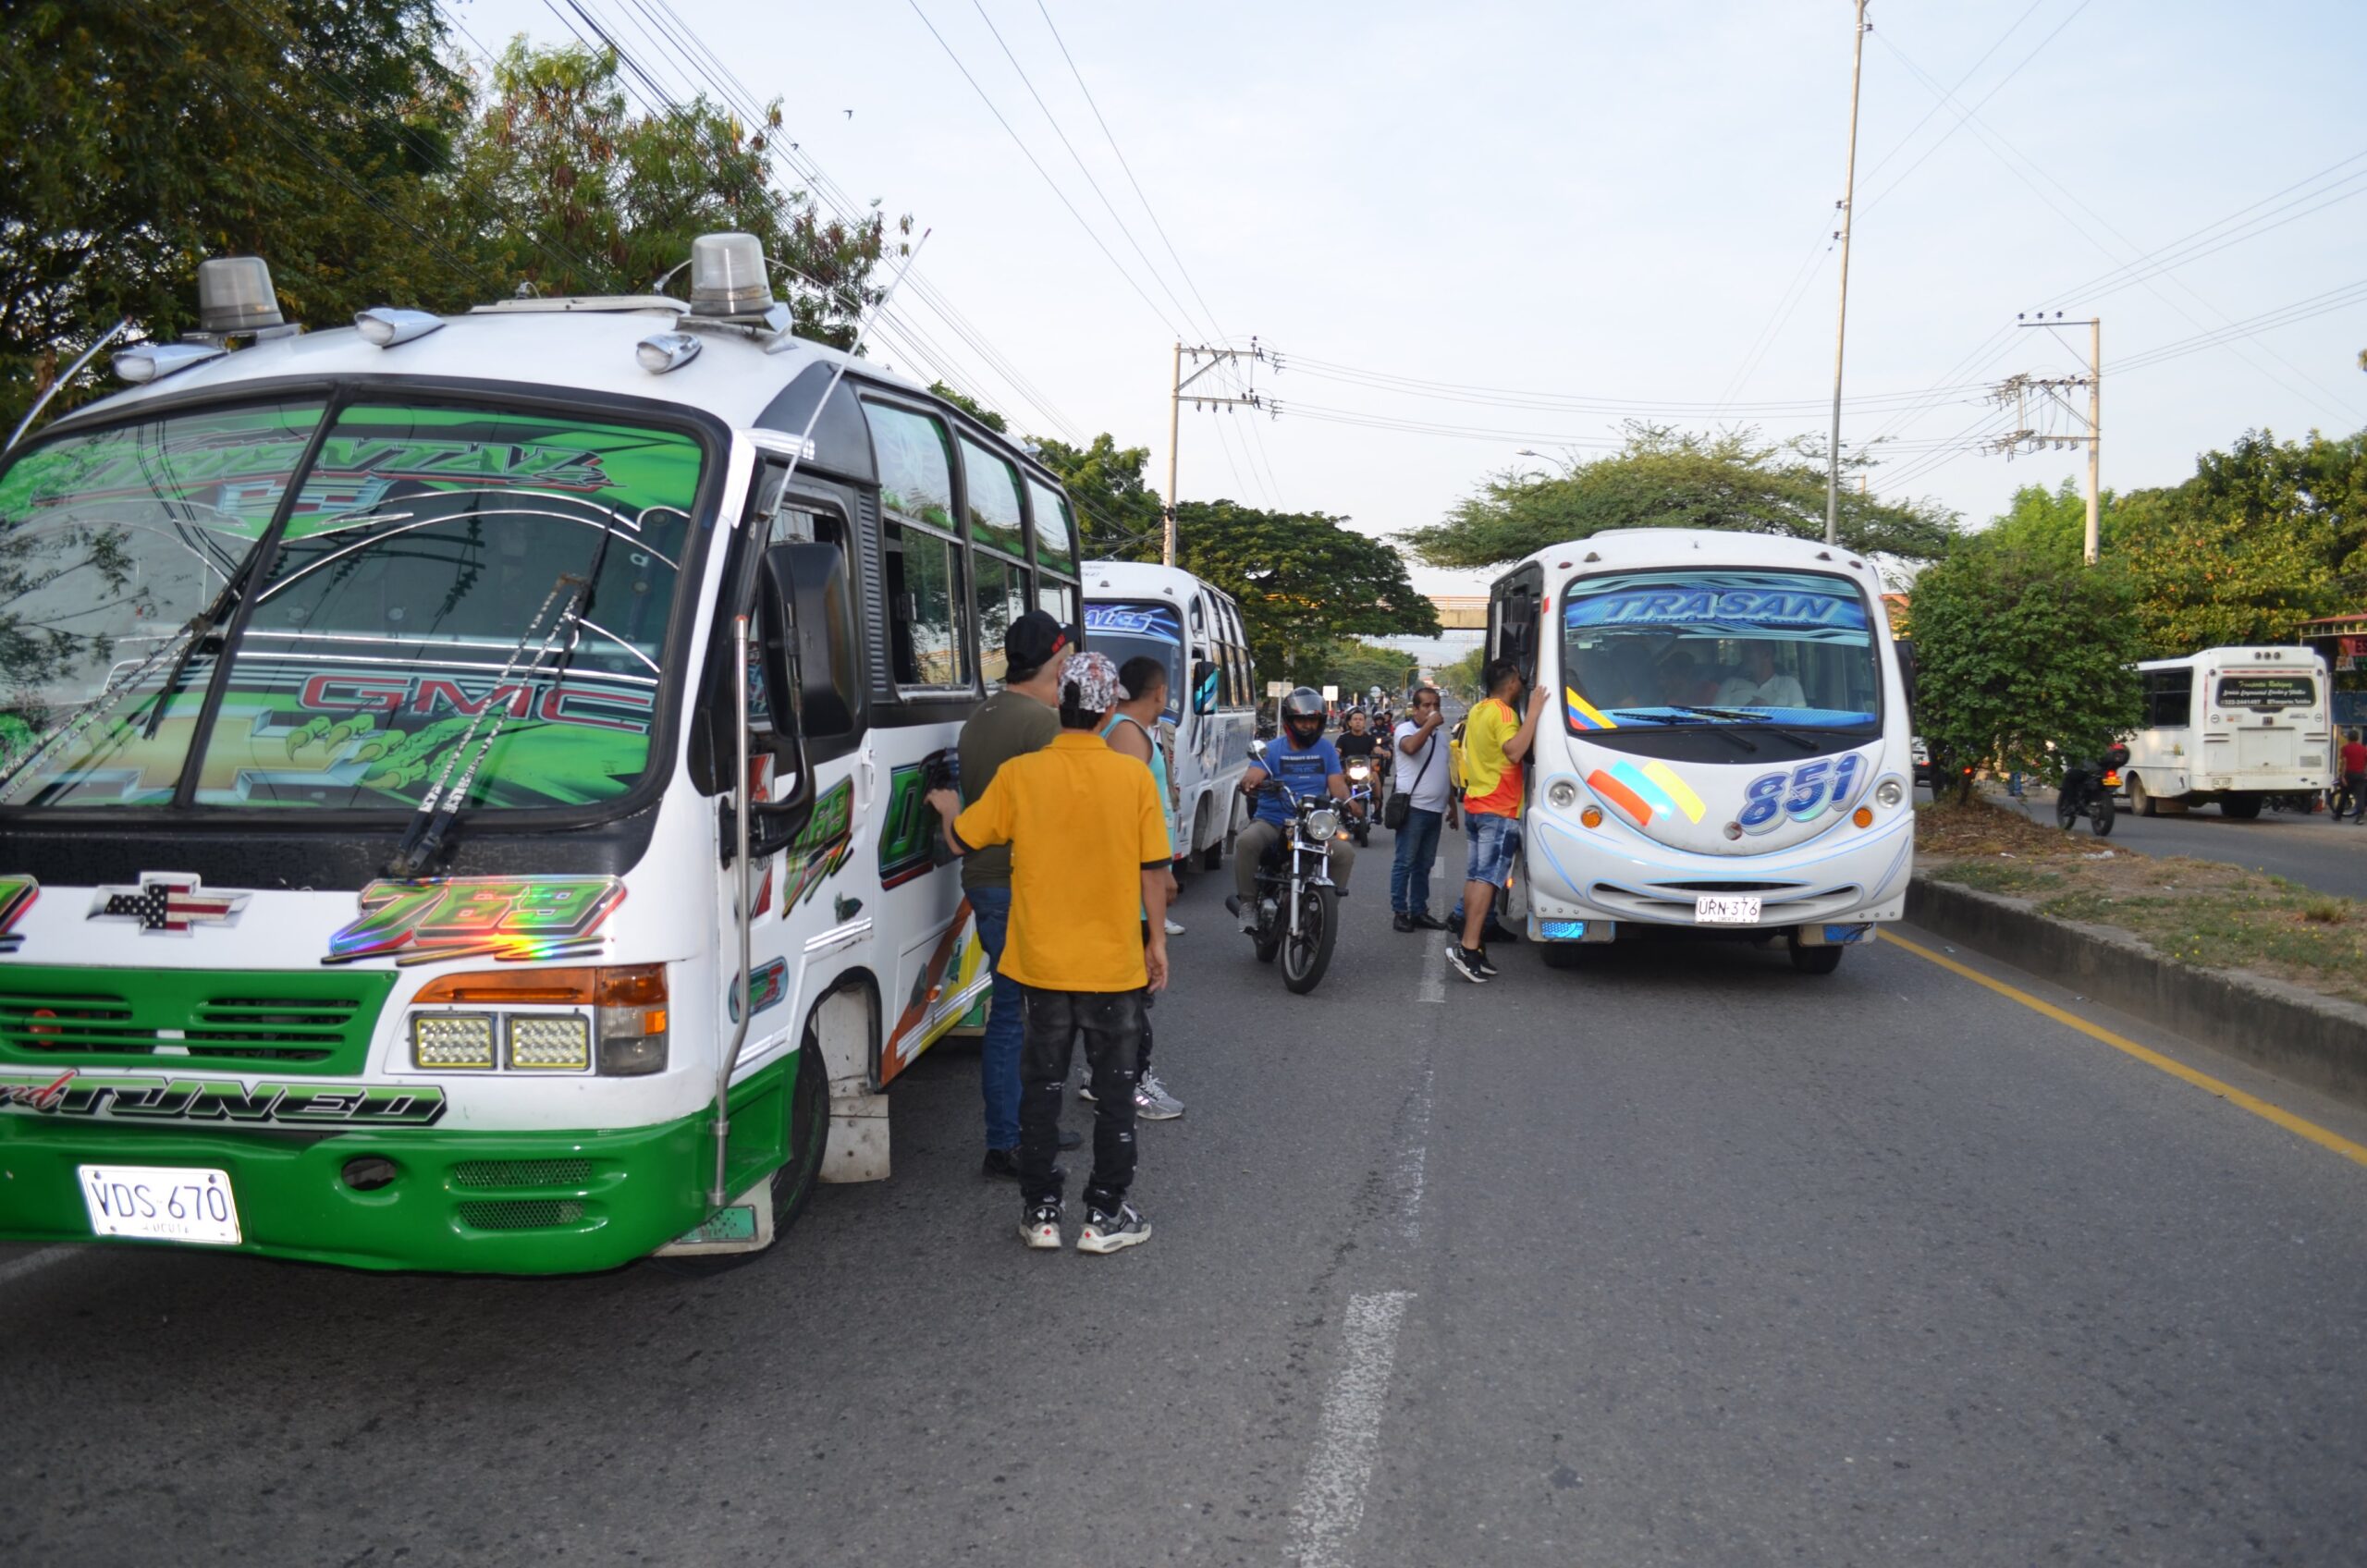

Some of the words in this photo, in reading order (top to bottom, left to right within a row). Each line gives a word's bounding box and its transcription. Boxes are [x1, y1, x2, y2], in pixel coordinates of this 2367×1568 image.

[1605, 591, 1840, 620] TRASAN
[299, 671, 651, 735] GMC
[1736, 752, 1868, 836] 851
[330, 876, 628, 956] 769
